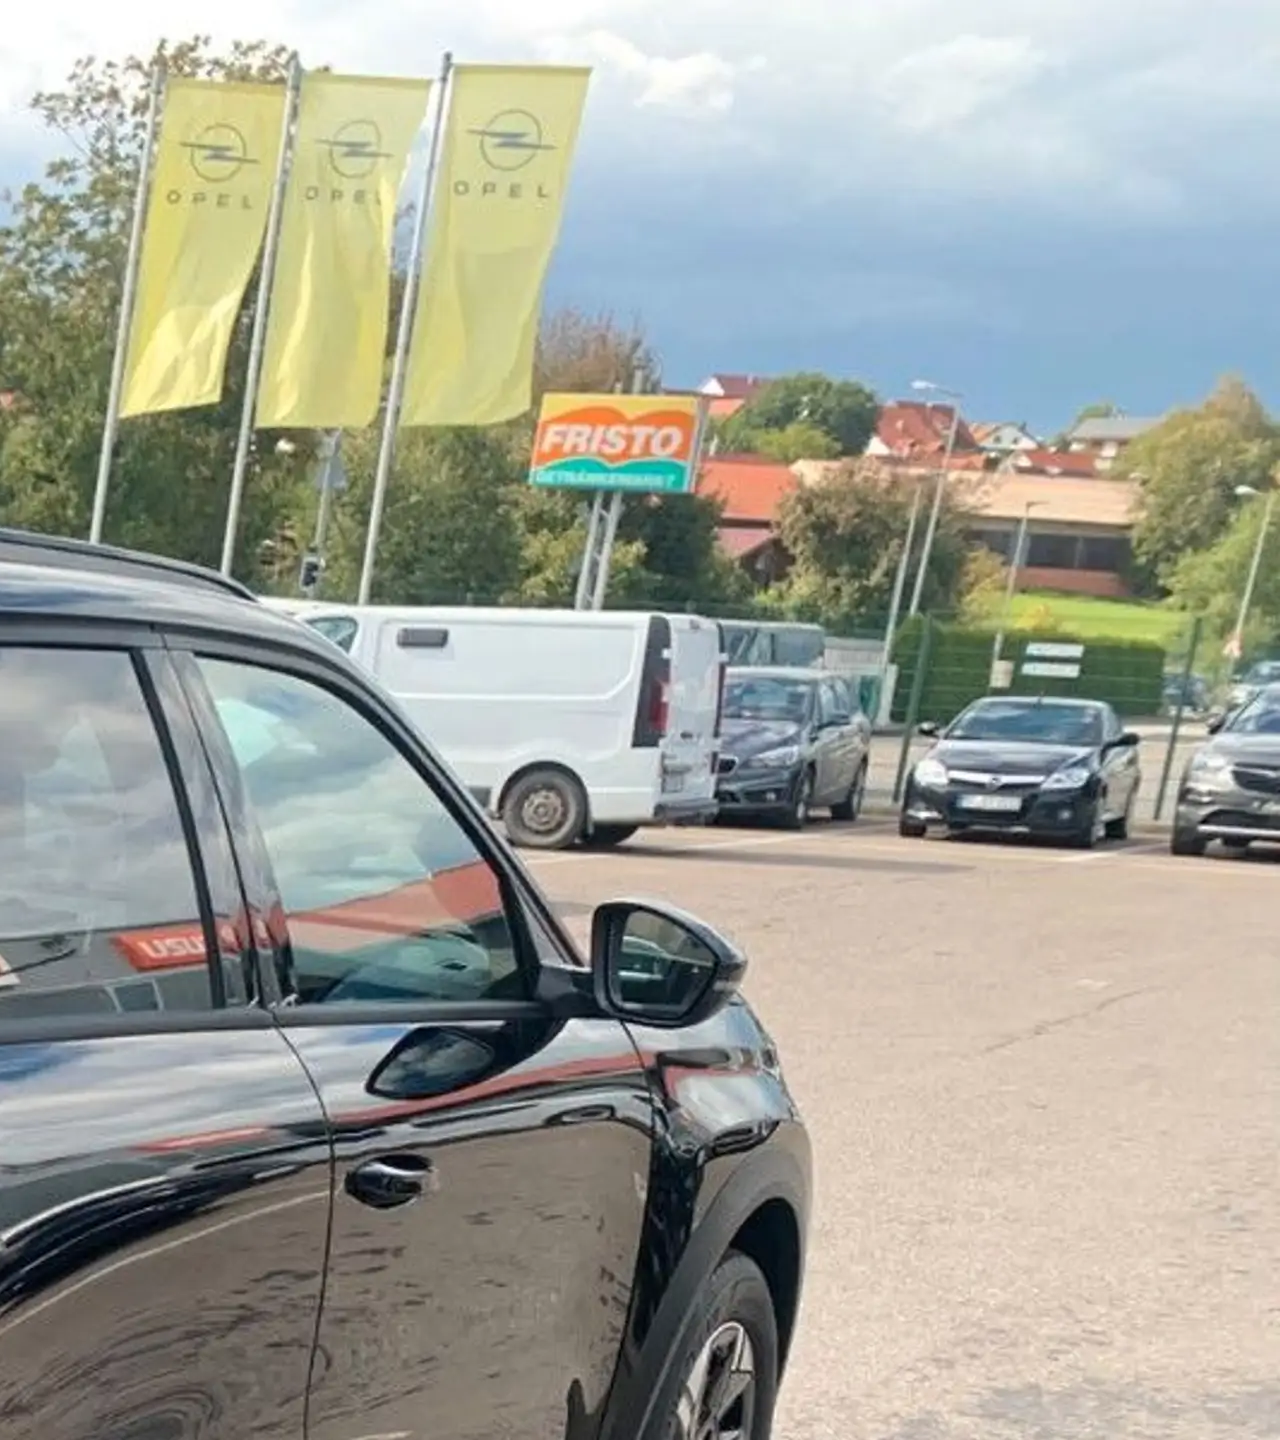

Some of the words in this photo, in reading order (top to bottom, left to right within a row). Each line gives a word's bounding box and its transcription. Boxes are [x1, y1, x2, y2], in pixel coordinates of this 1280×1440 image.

[306, 185, 383, 205] OPEL
[453, 180, 550, 199] OPEL
[167, 190, 254, 209] OPEL
[541, 423, 683, 457] FRISTO
